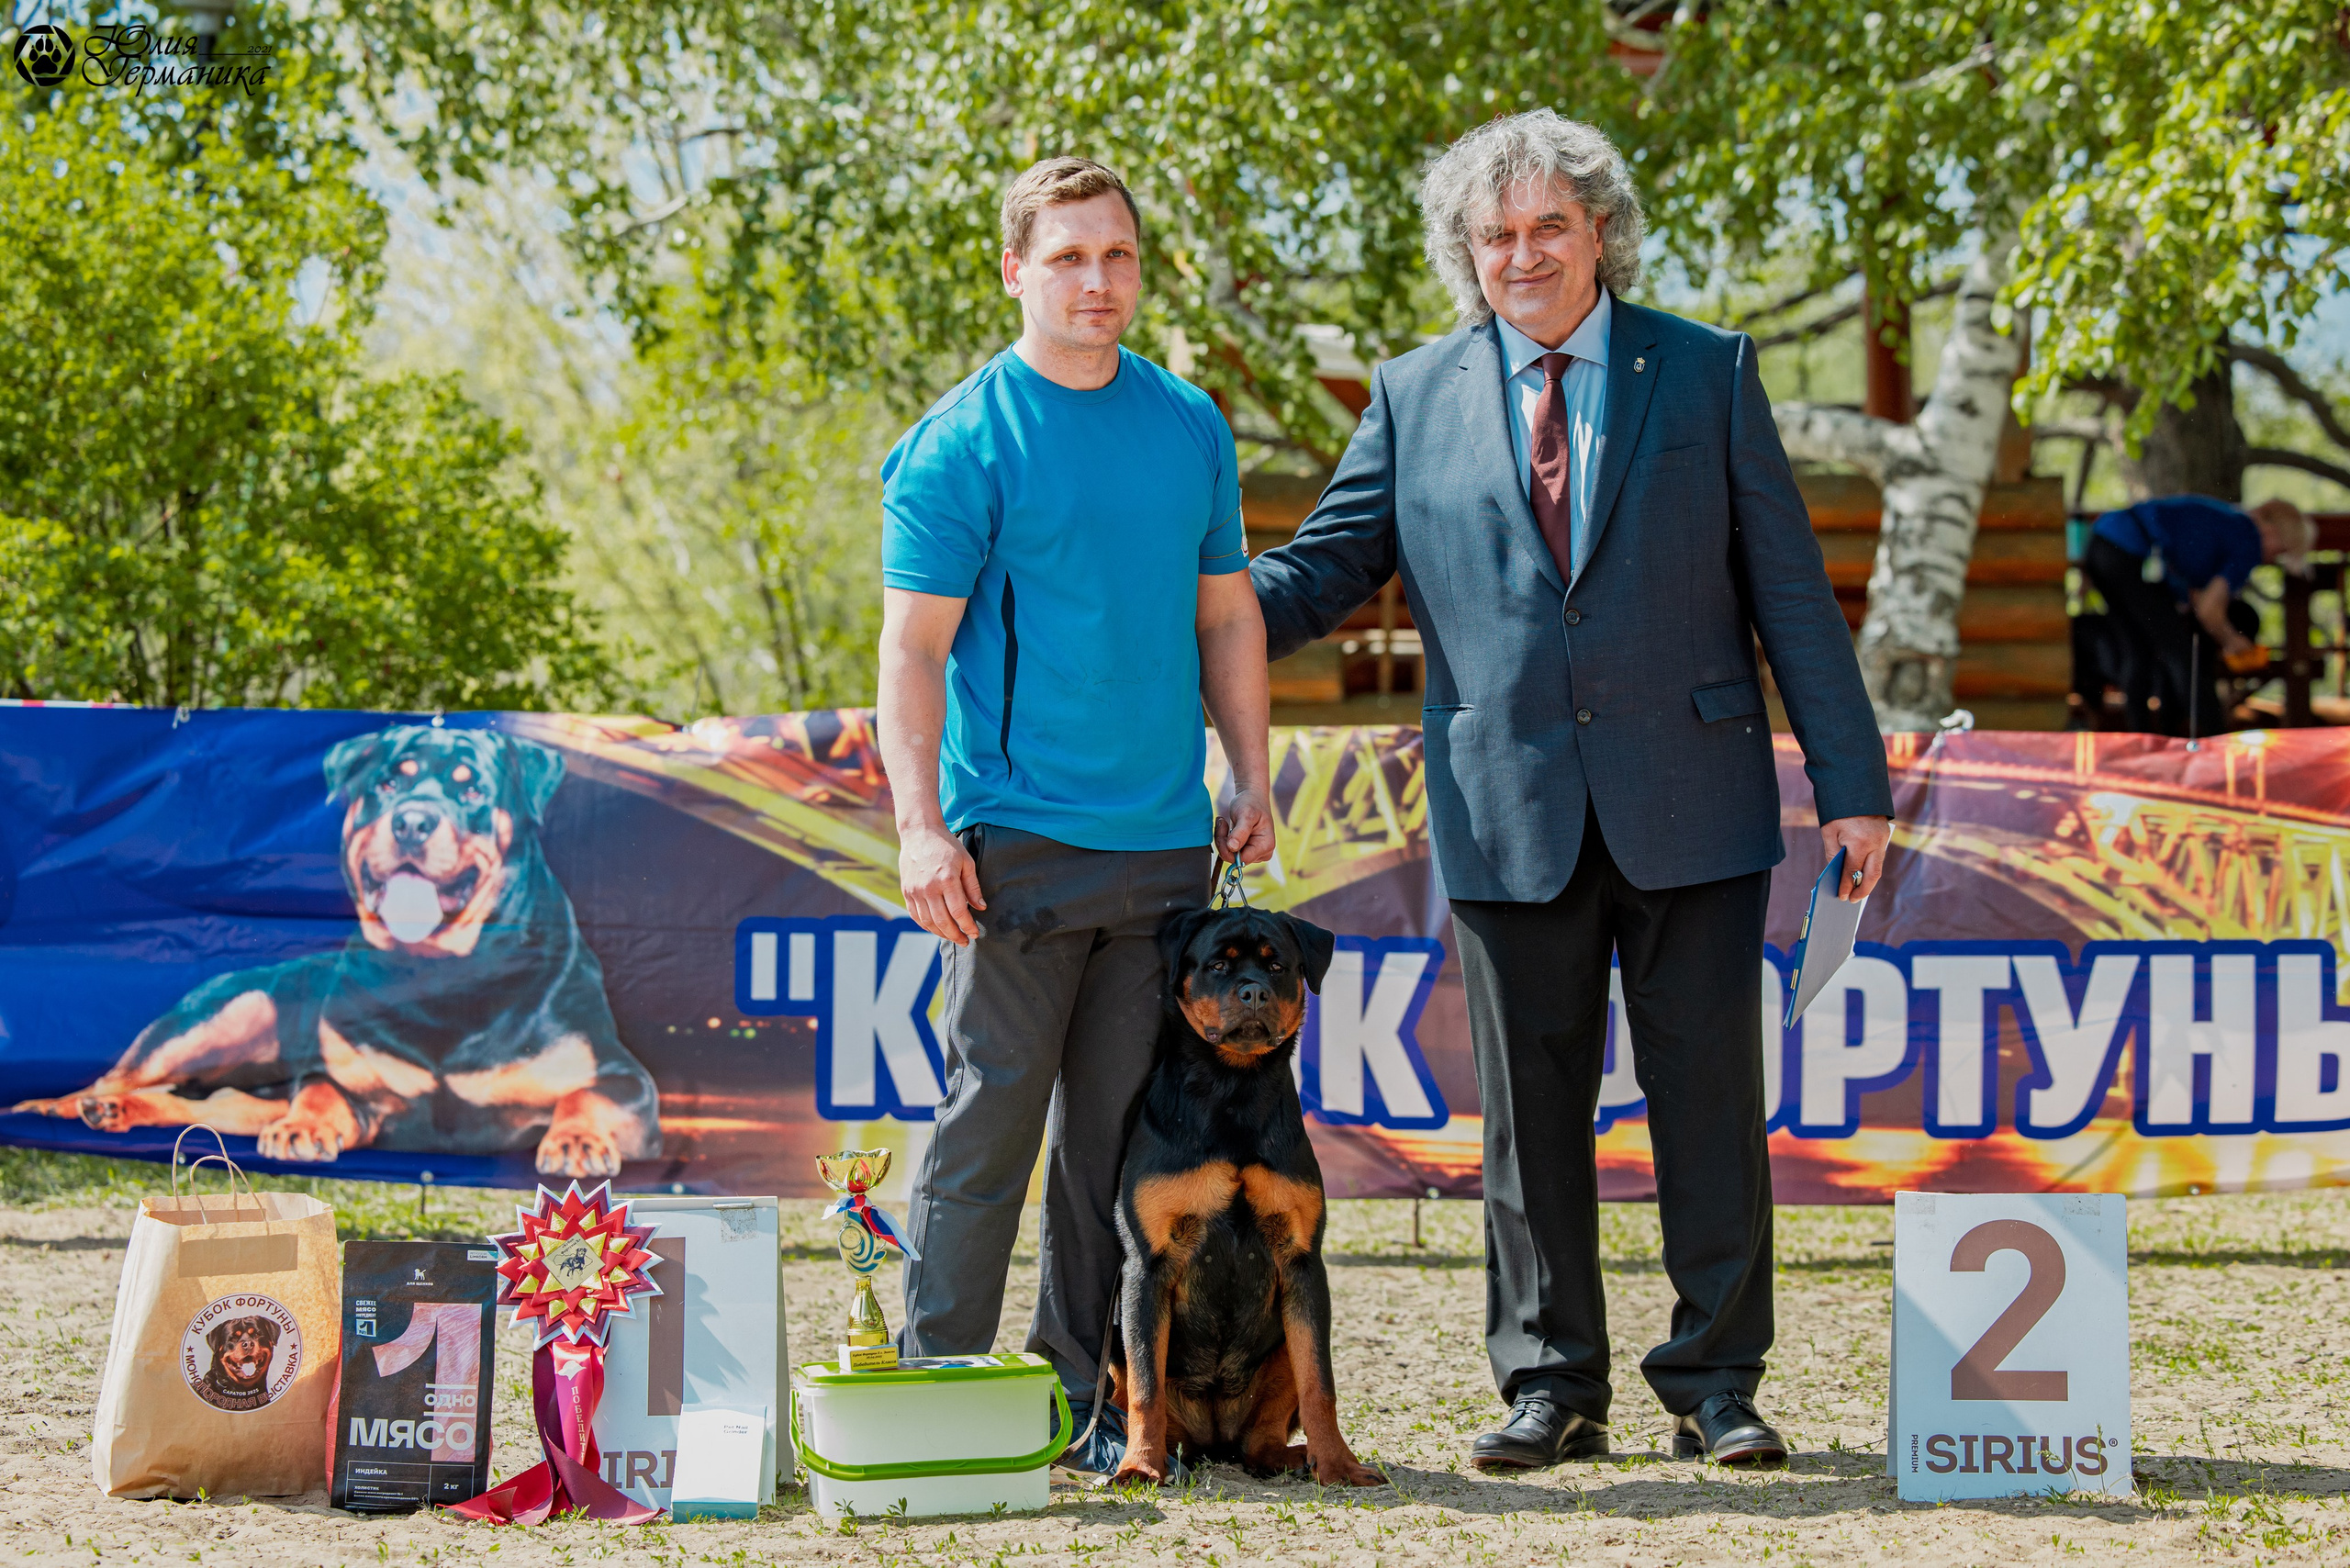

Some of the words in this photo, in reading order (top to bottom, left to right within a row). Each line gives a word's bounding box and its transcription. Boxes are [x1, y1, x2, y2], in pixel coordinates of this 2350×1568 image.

[191, 1299, 232, 1335] КУБОК
[235, 1297, 296, 1335] ФОРТУНЫ
[1950, 1219, 2069, 1402] 2
[185, 1354, 257, 1409] МОНОПОРОДНАЯ
[258, 1352, 298, 1406] ВЫСТАВКА
[222, 1388, 247, 1396] САРАТОВ
[424, 1393, 476, 1408] ОДНО
[349, 1417, 475, 1451] МЯСО
[1925, 1433, 2109, 1476] SIRIUS
